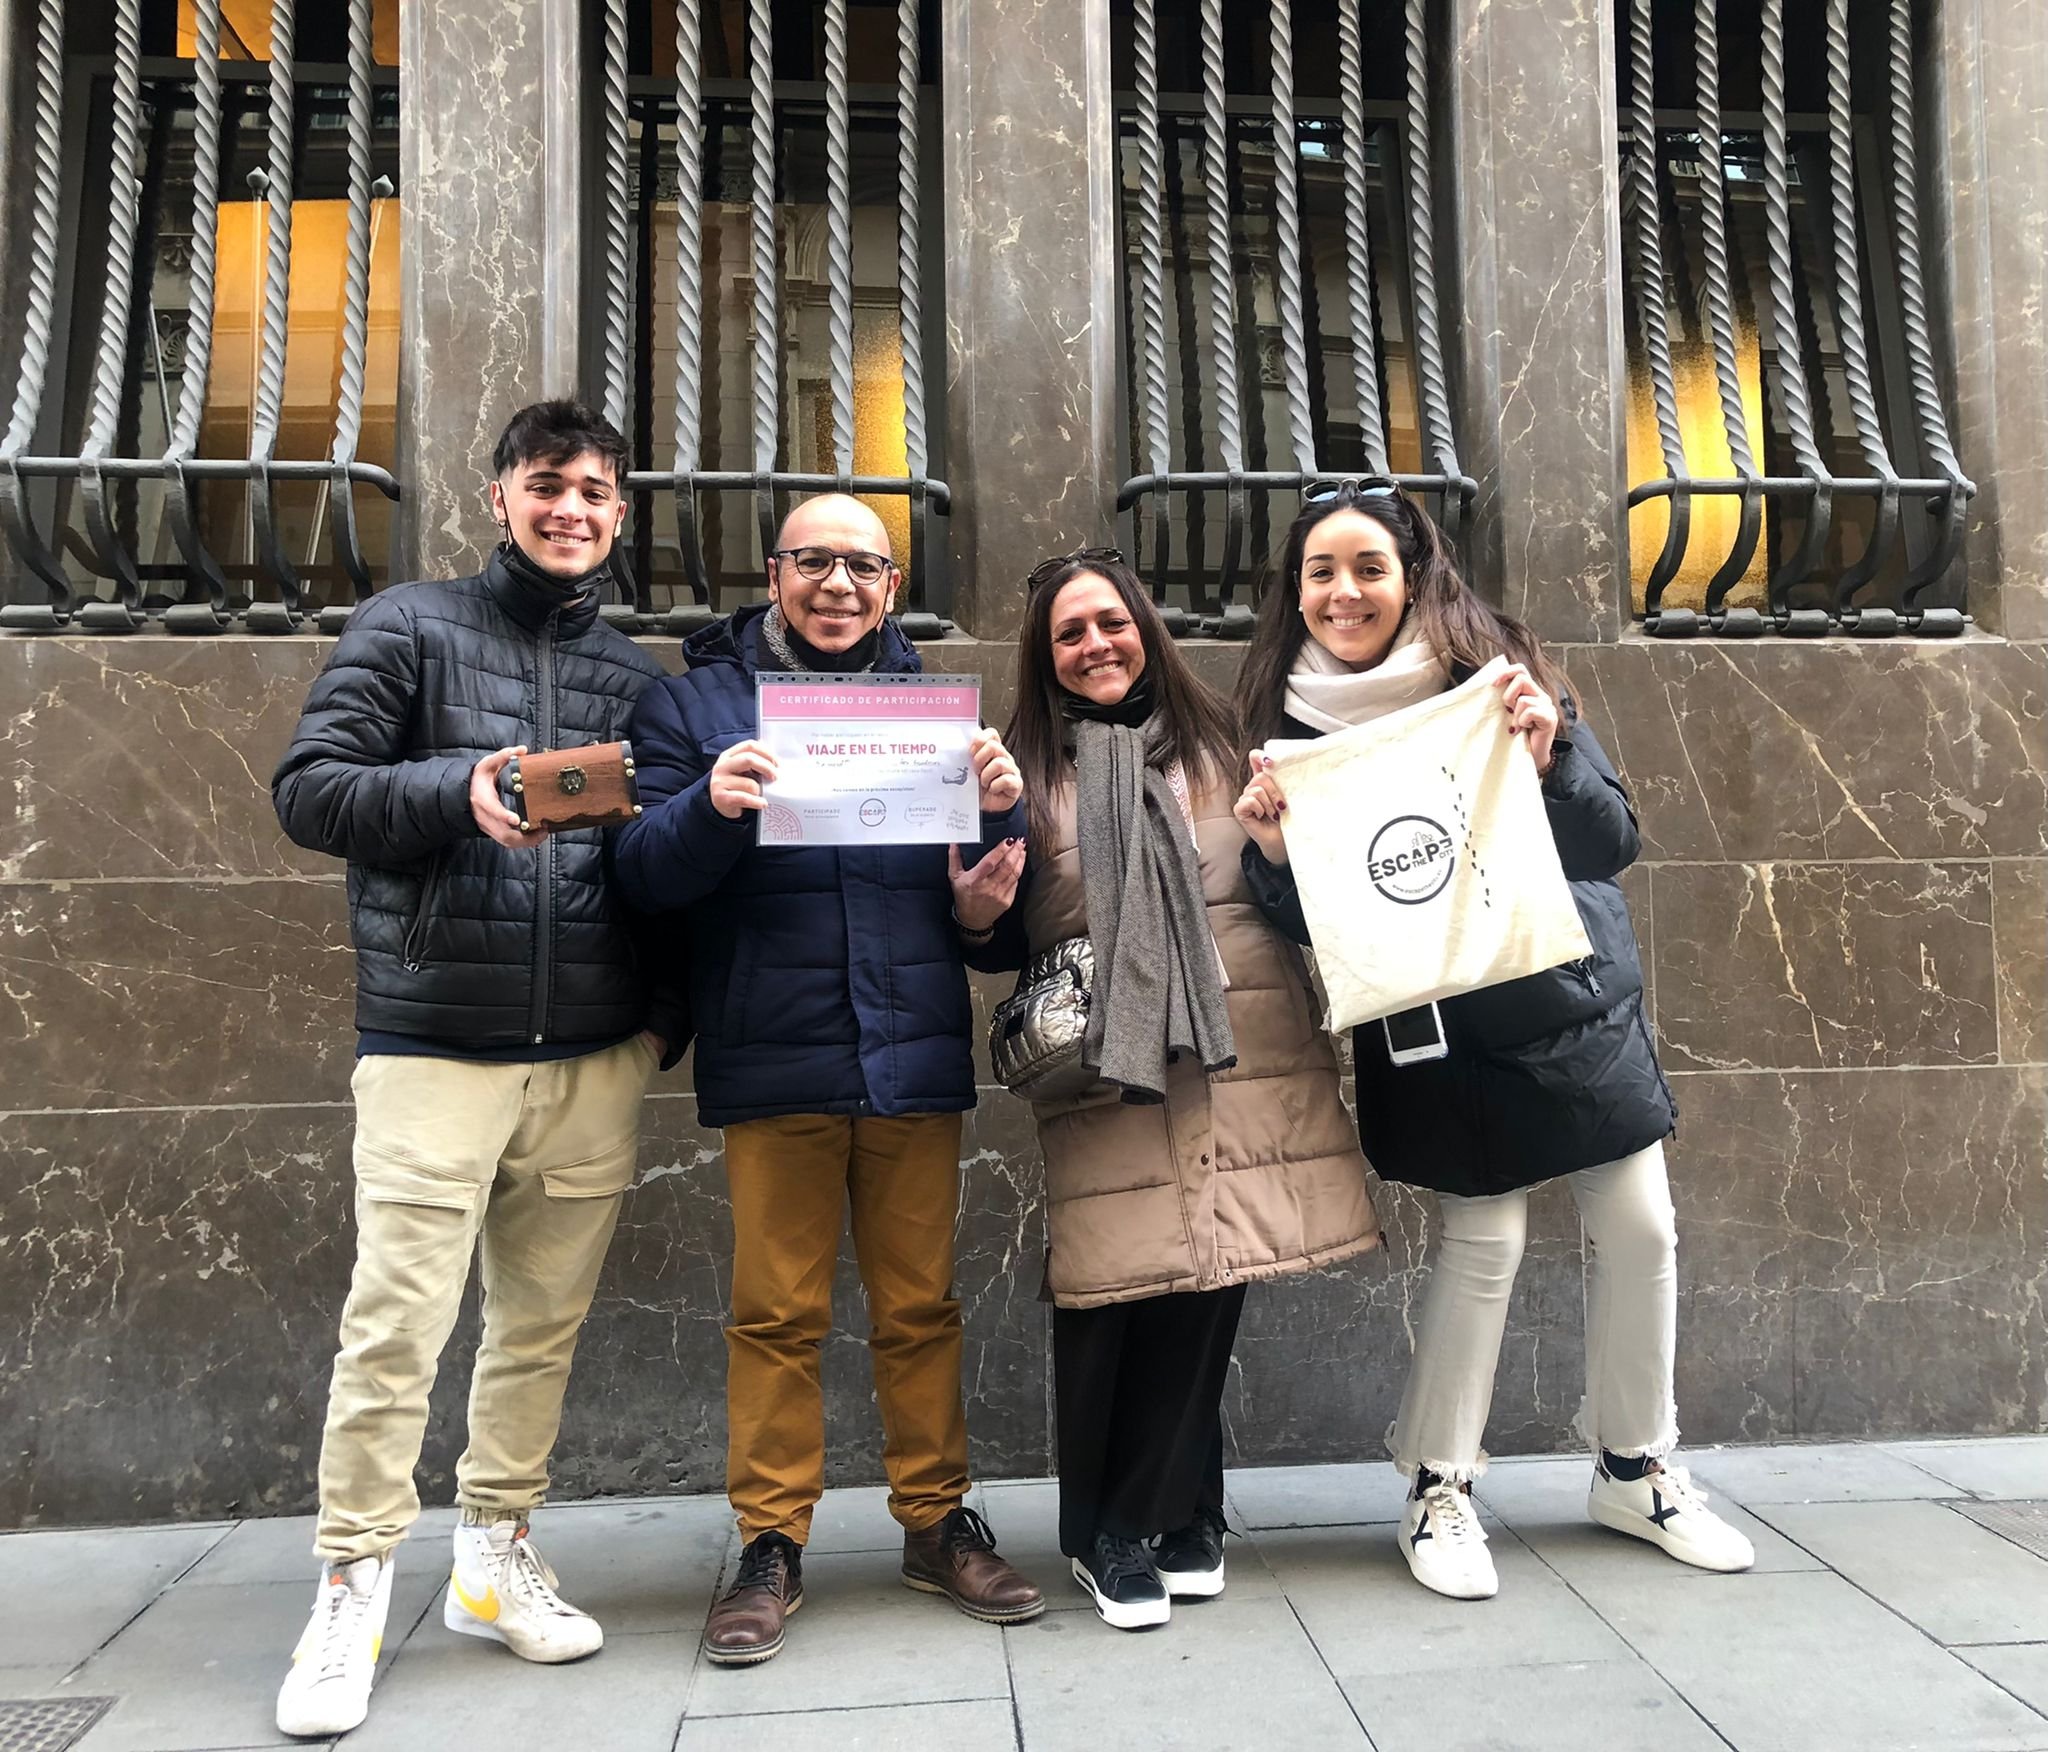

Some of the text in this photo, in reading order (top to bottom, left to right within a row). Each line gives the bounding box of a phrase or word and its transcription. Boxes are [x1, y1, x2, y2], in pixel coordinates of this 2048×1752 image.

[780, 694, 960, 705] CERTIFICADO DE PARTICIPACIÓN
[806, 743, 936, 756] VIAJE EN EL TIEMPO
[1412, 857, 1428, 868] THE
